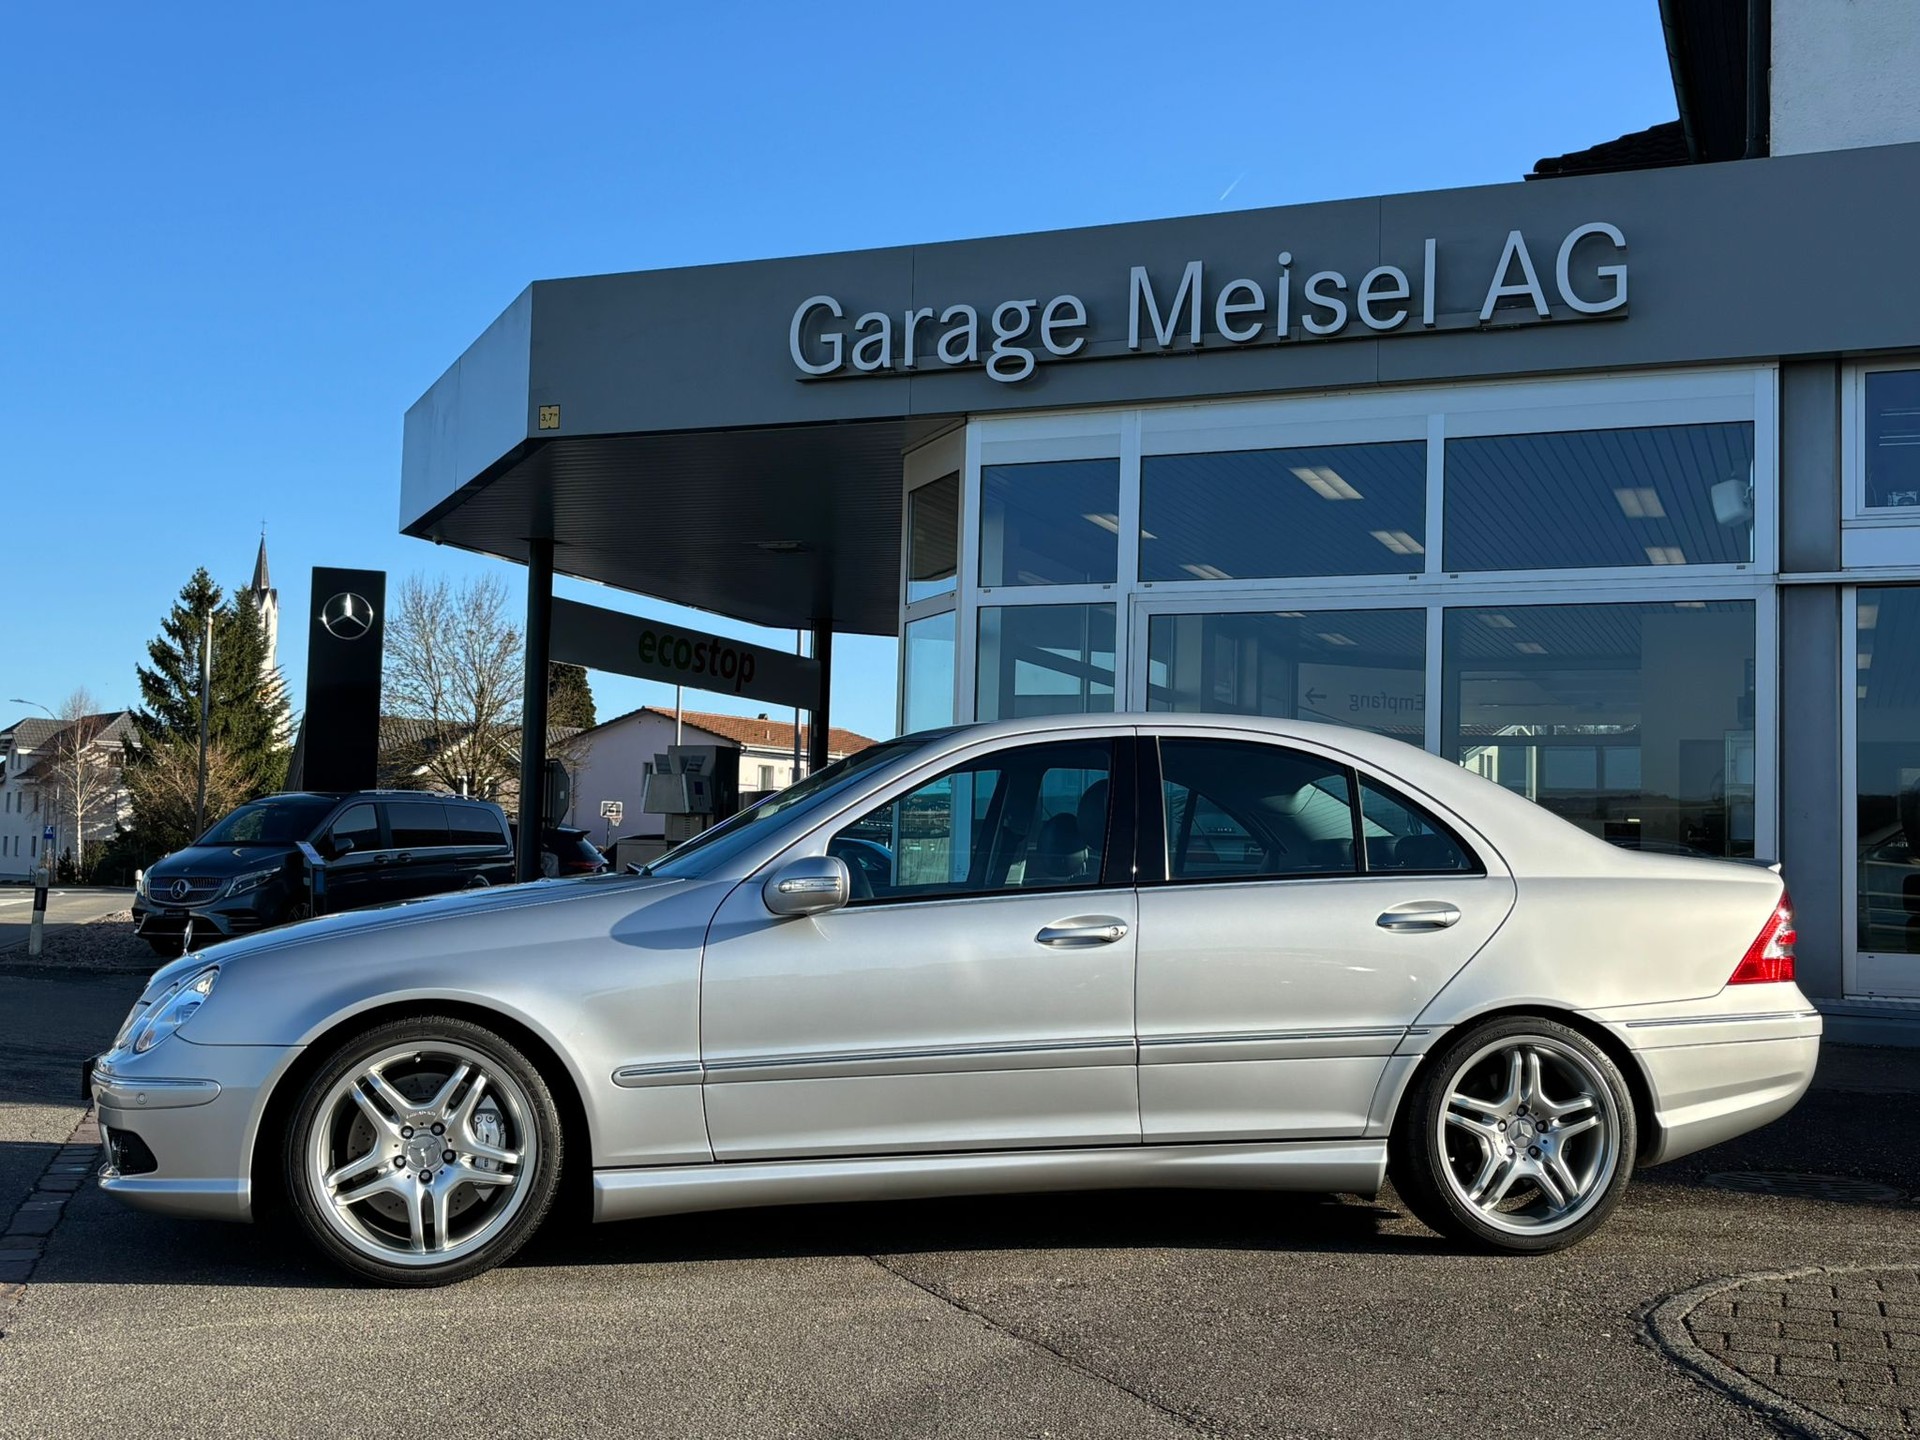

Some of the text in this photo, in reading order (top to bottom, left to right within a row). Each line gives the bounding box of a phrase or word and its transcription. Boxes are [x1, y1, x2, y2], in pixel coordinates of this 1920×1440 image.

[789, 221, 1629, 383] Garage Meisel AG
[638, 630, 756, 693] ecostop
